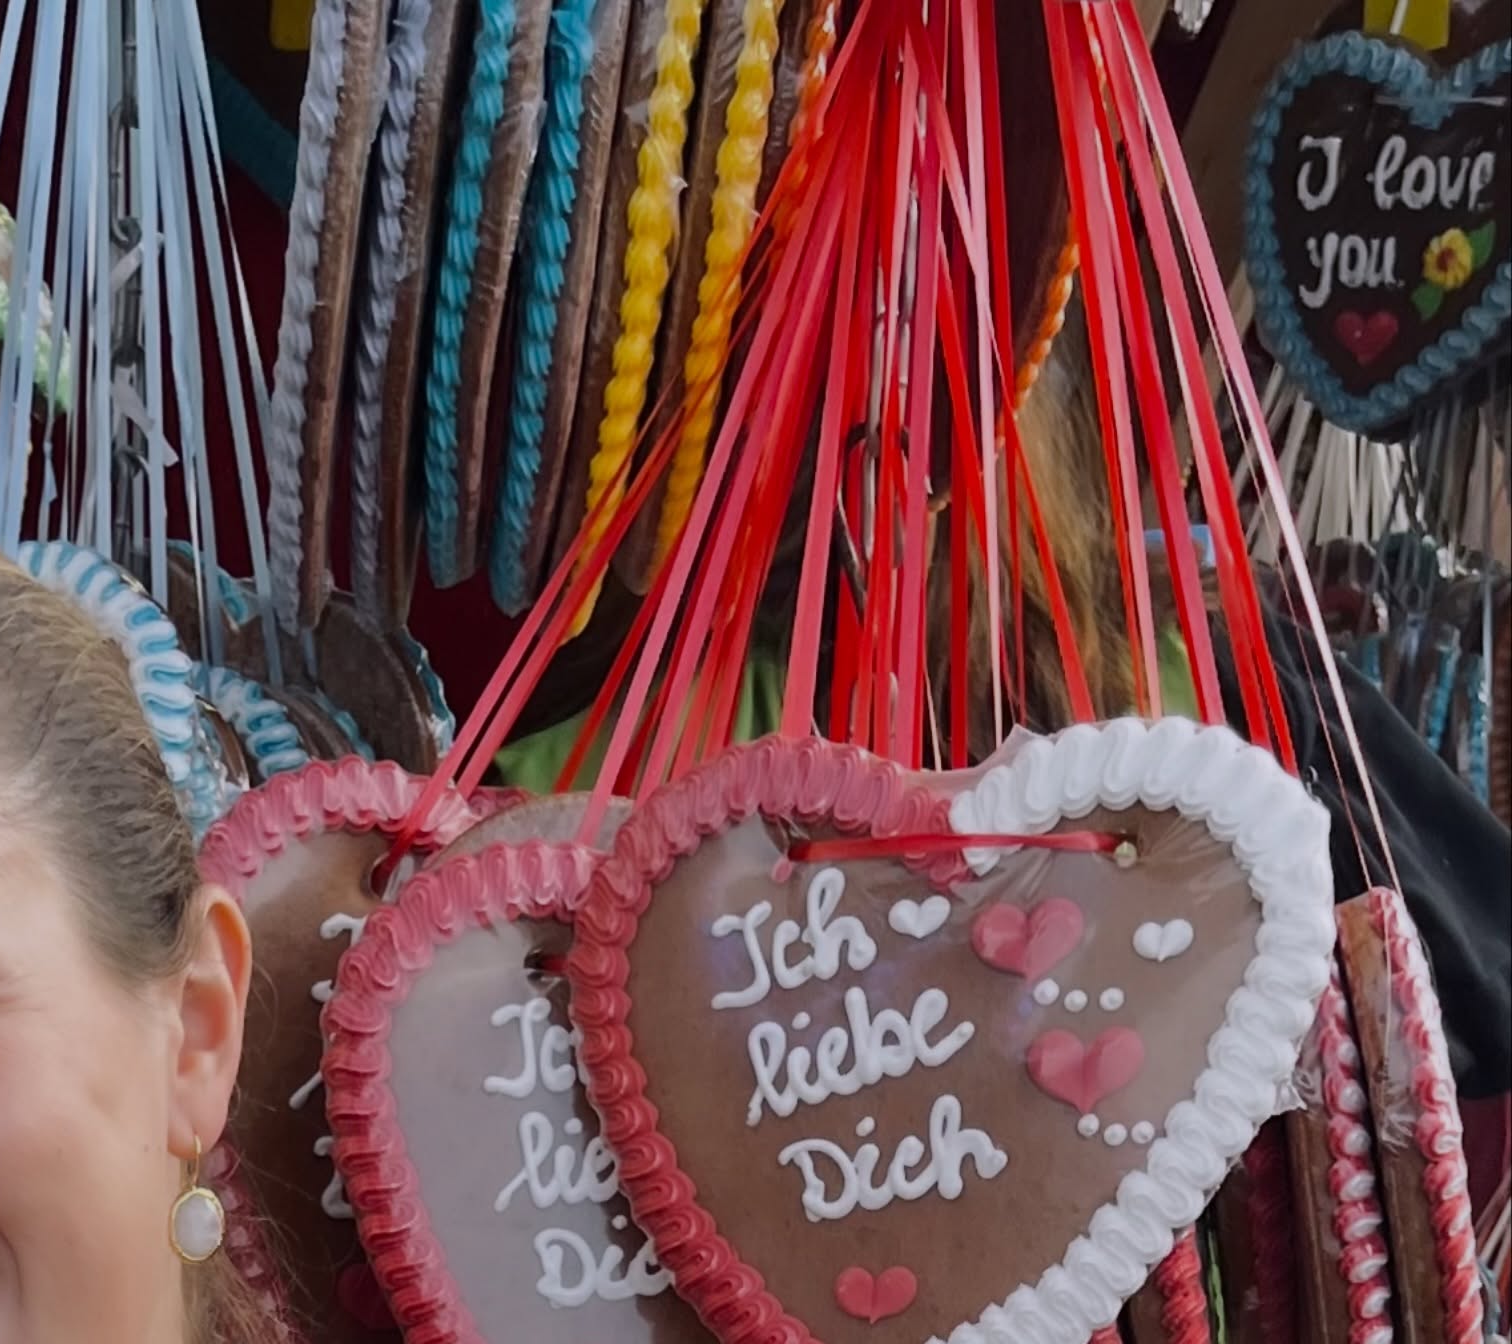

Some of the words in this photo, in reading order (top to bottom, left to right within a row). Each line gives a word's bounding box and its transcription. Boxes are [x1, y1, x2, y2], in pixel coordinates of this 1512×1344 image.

[1365, 134, 1497, 212] love
[711, 867, 878, 1010] Ich
[483, 996, 590, 1099] Ic
[745, 986, 976, 1128] liebe
[493, 1111, 622, 1213] lie
[778, 1094, 1009, 1224] Dich
[533, 1214, 676, 1310] Dic
